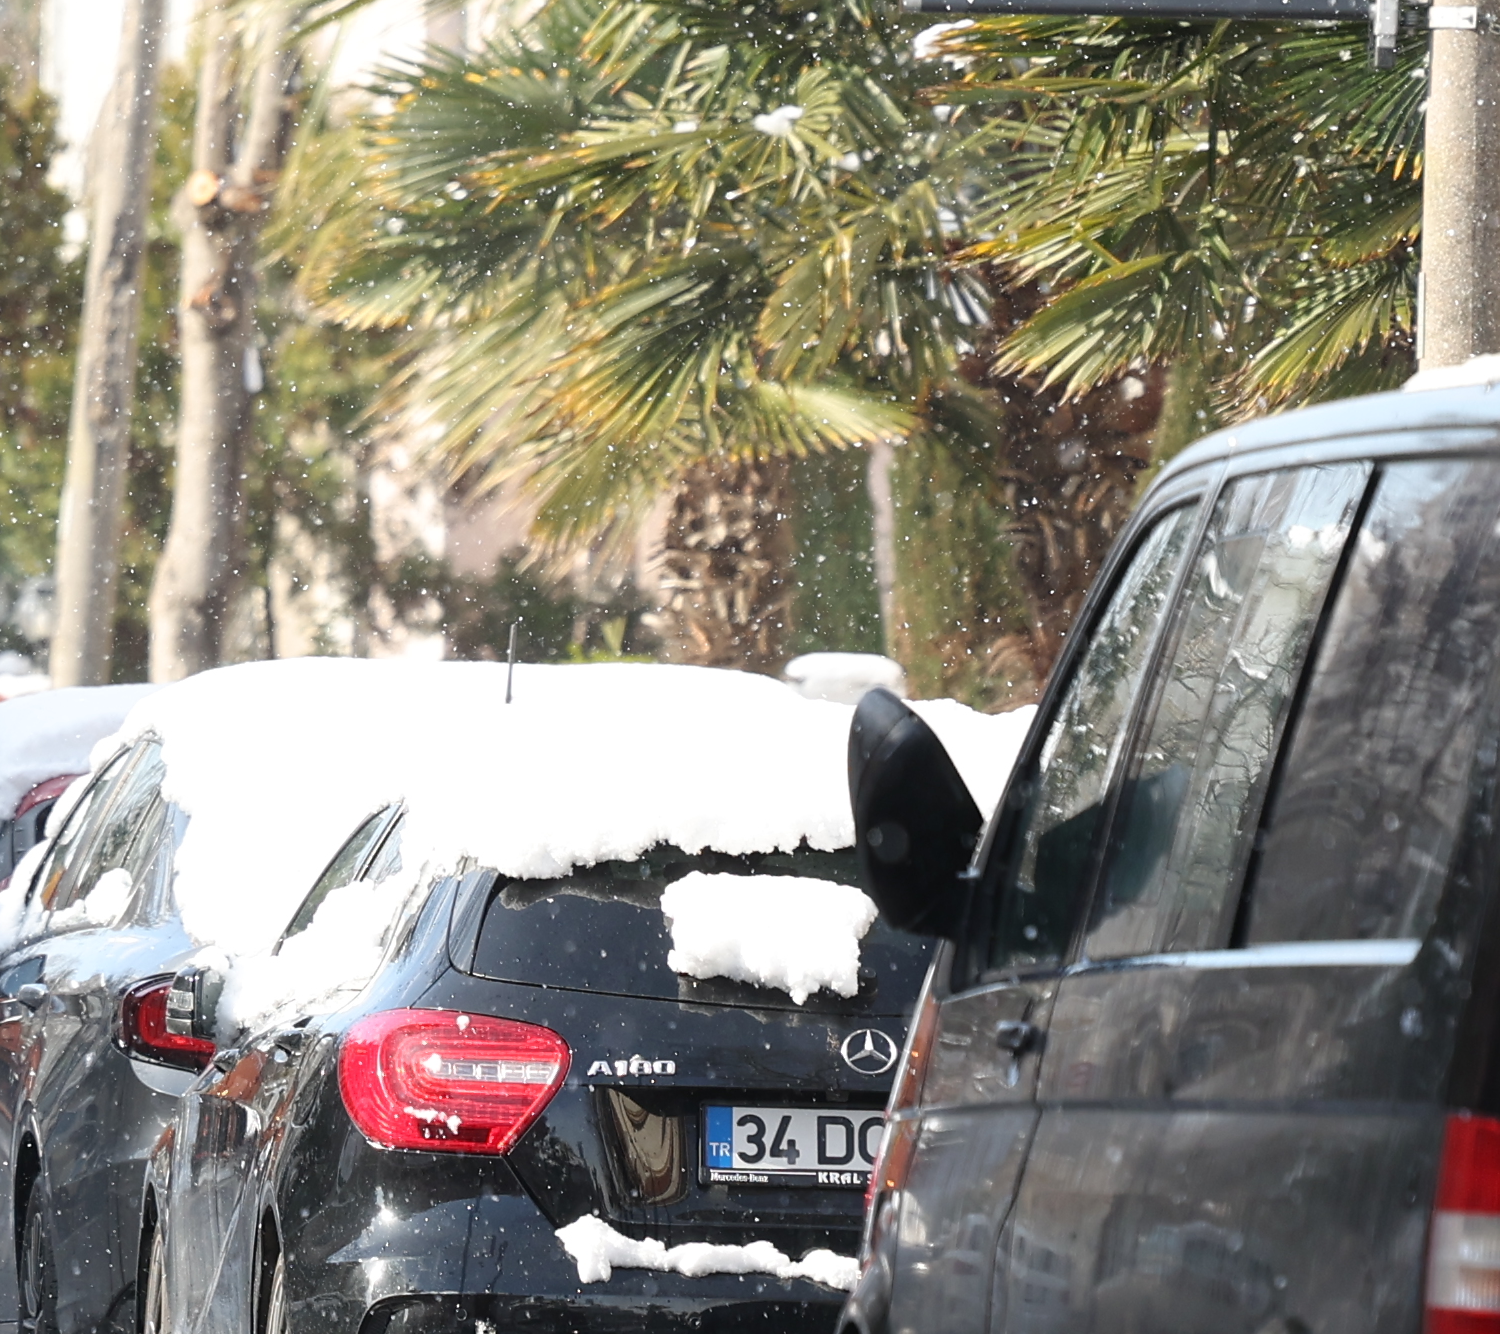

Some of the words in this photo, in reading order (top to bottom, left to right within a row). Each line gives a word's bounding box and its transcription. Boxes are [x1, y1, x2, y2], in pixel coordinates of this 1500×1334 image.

[586, 1059, 676, 1076] A180
[736, 1114, 800, 1165] 34
[709, 1142, 731, 1157] TR
[817, 1171, 862, 1185] KRAL
